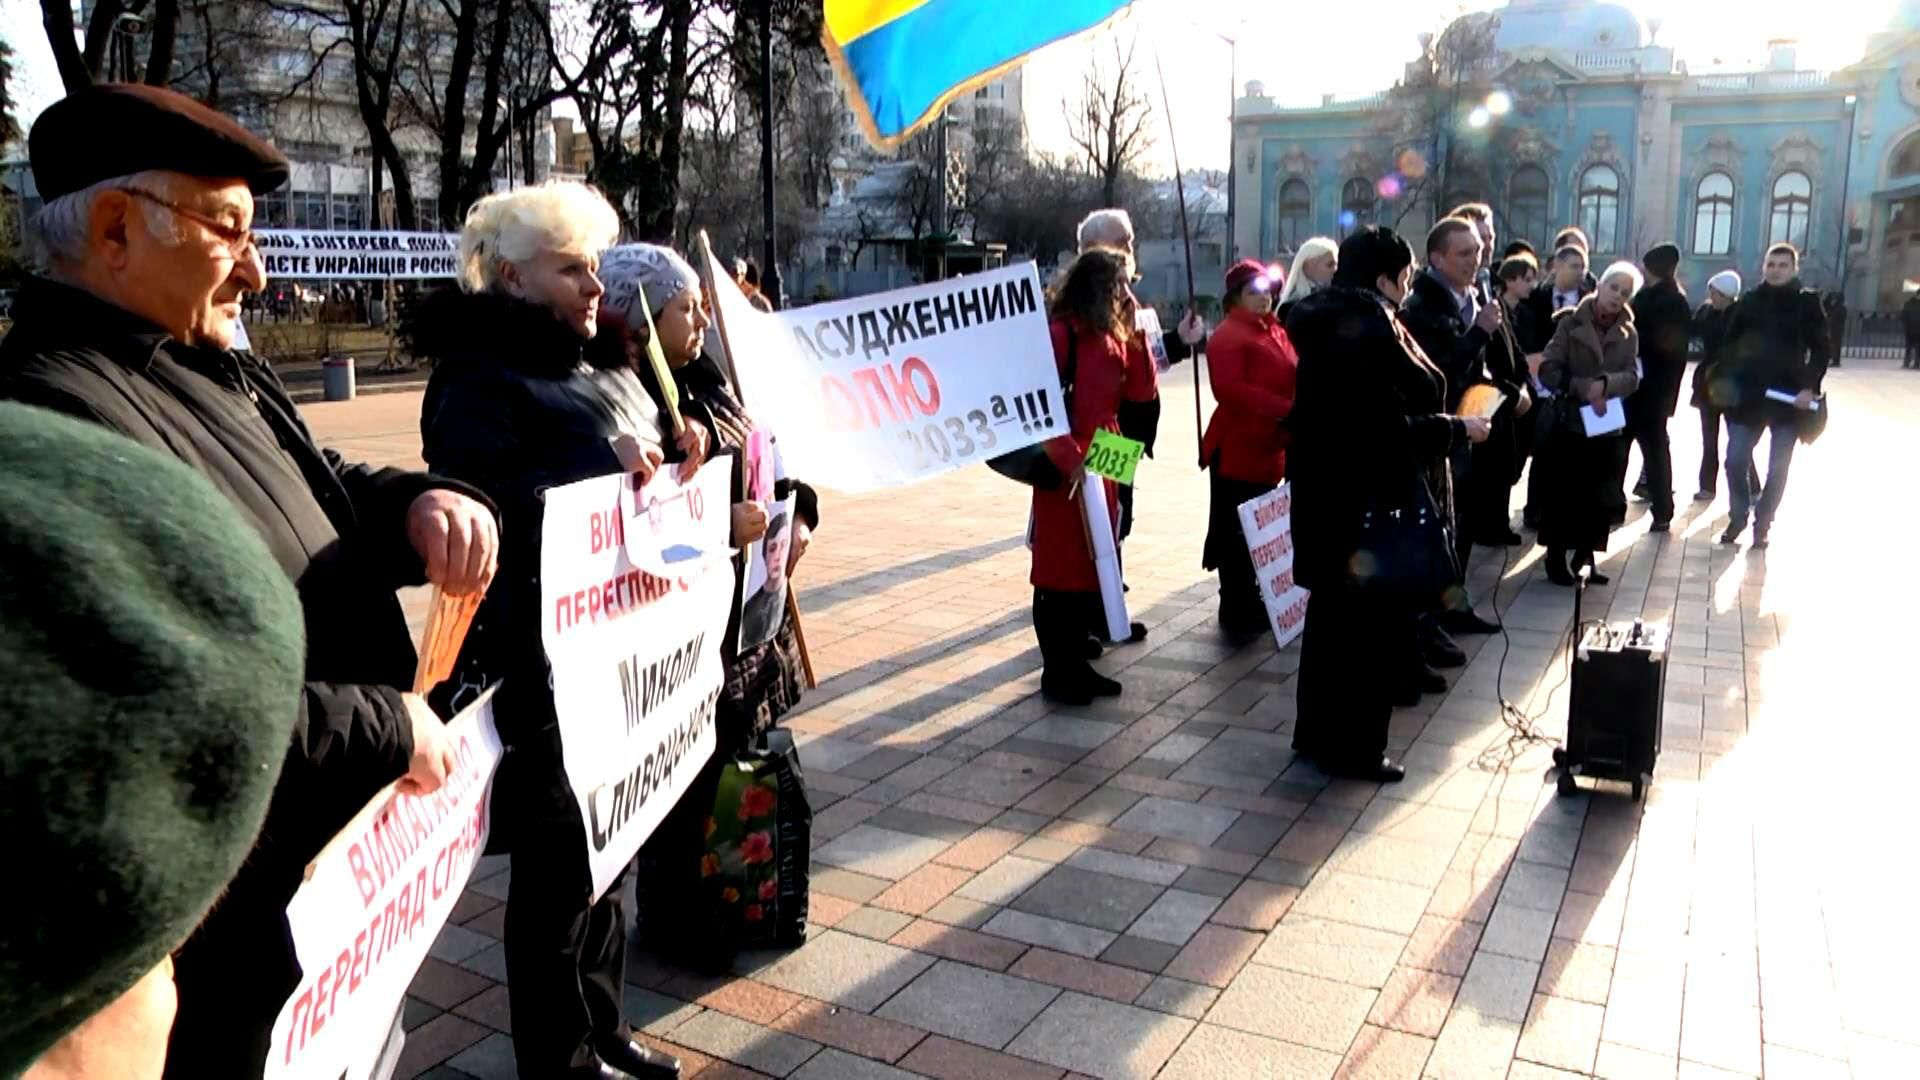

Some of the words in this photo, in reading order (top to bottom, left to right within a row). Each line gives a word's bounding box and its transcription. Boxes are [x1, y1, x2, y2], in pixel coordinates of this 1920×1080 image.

[260, 255, 310, 274] АЄТЕ
[315, 252, 406, 277] УКРАЇНЦІВ
[285, 865, 427, 1066] ПЕРЕГЛЯД
